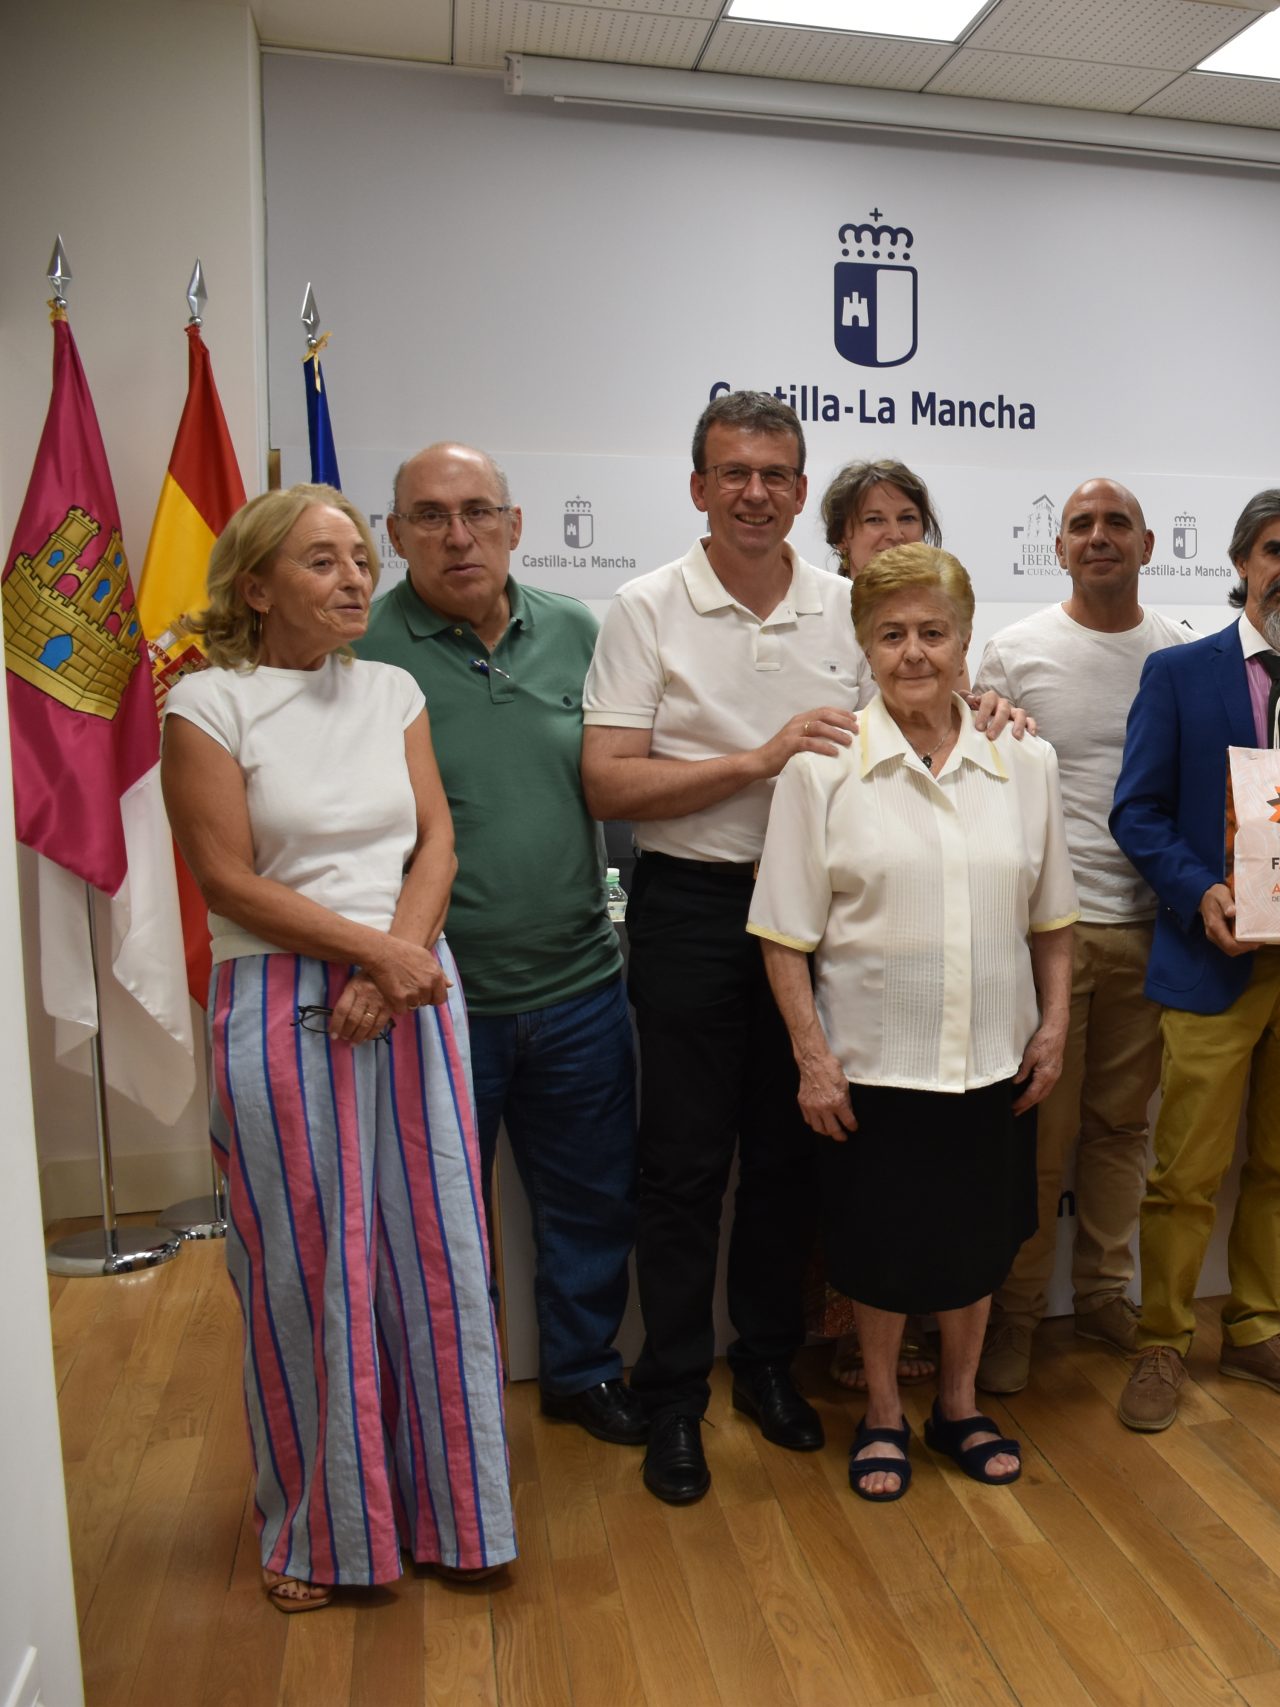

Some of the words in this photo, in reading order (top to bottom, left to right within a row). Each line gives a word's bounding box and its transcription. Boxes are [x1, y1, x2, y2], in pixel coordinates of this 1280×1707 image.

[911, 391, 1036, 430] Mancha
[1022, 544, 1057, 553] EDIFIC
[522, 554, 587, 568] Castilla-La
[591, 555, 636, 568] Mancha
[1022, 554, 1057, 566] IBERI
[1027, 568, 1063, 576] CUENCA
[1195, 565, 1232, 577] Mancha
